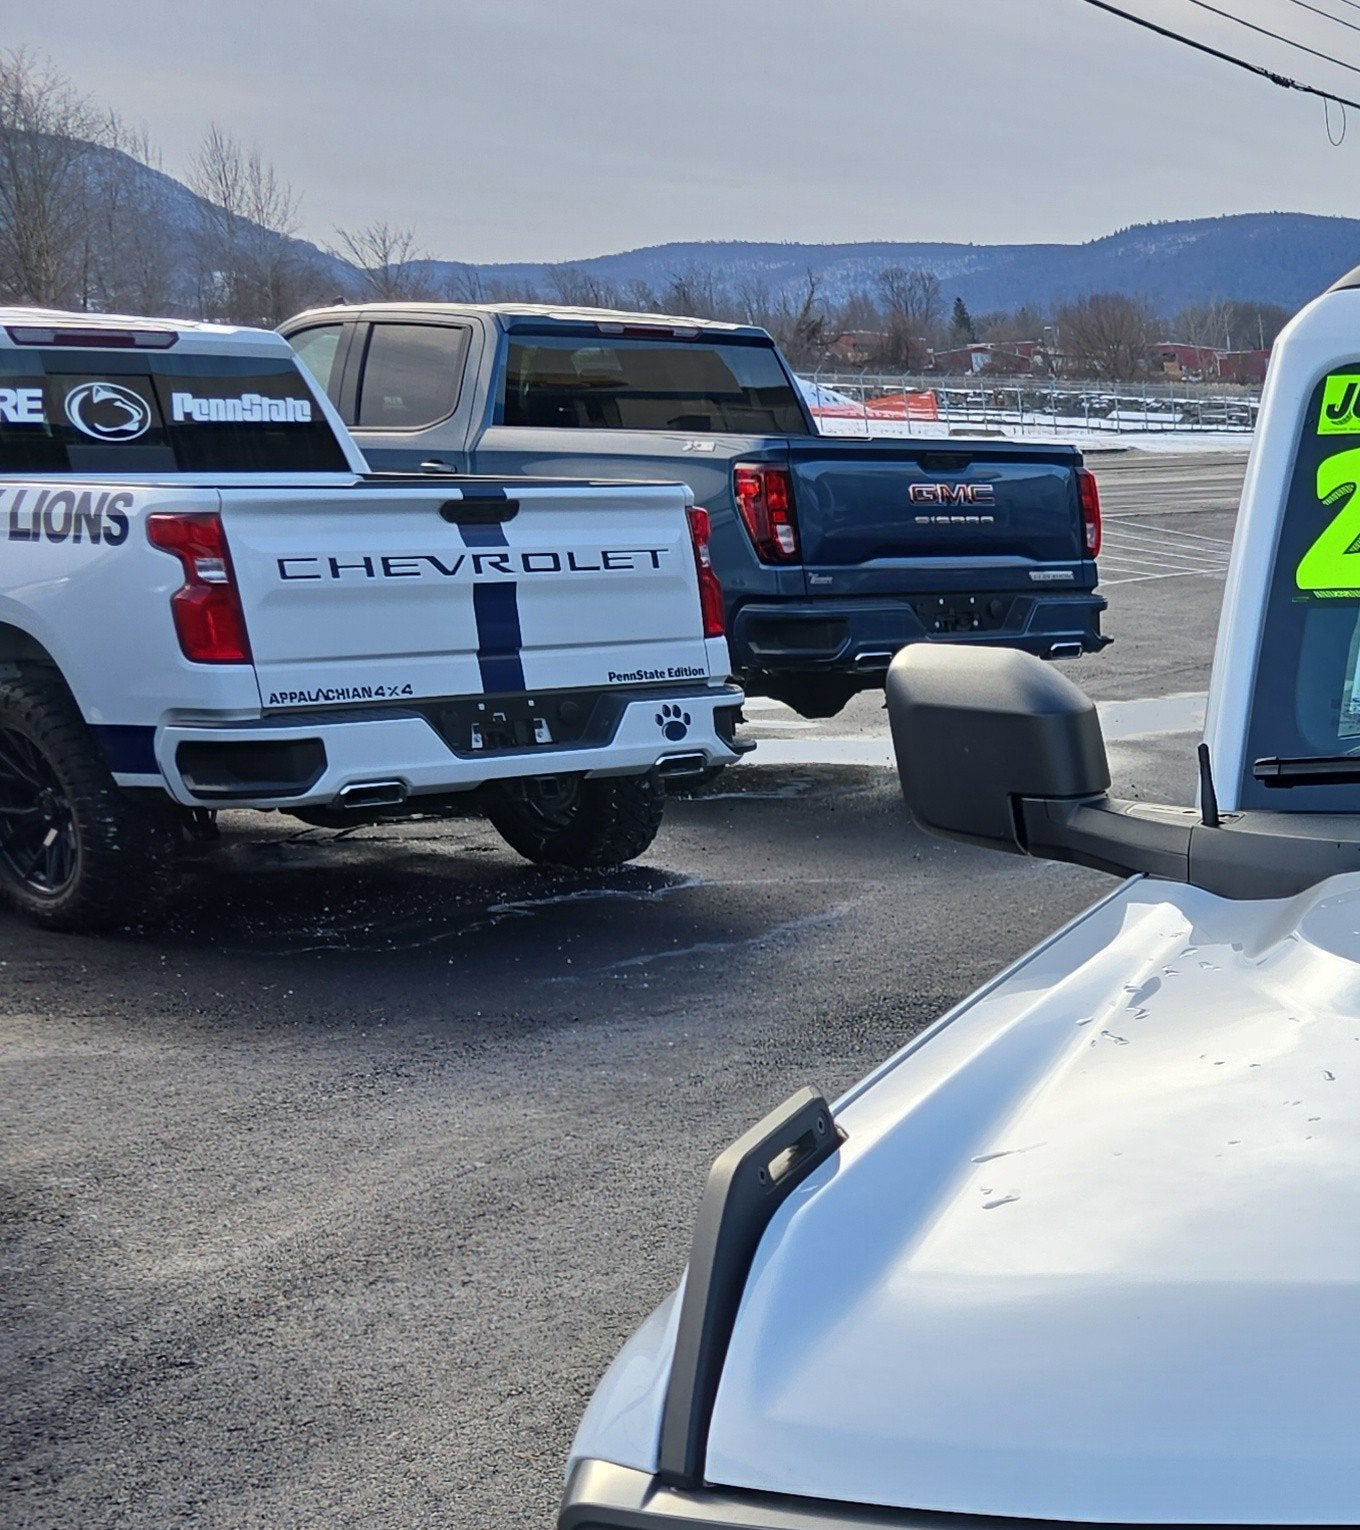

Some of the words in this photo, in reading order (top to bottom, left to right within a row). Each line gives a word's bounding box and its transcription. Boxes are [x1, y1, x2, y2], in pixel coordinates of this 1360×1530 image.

[908, 484, 996, 507] GMC
[8, 489, 134, 546] LIONS
[277, 548, 669, 580] CHEVROLET
[667, 666, 705, 678] Edition
